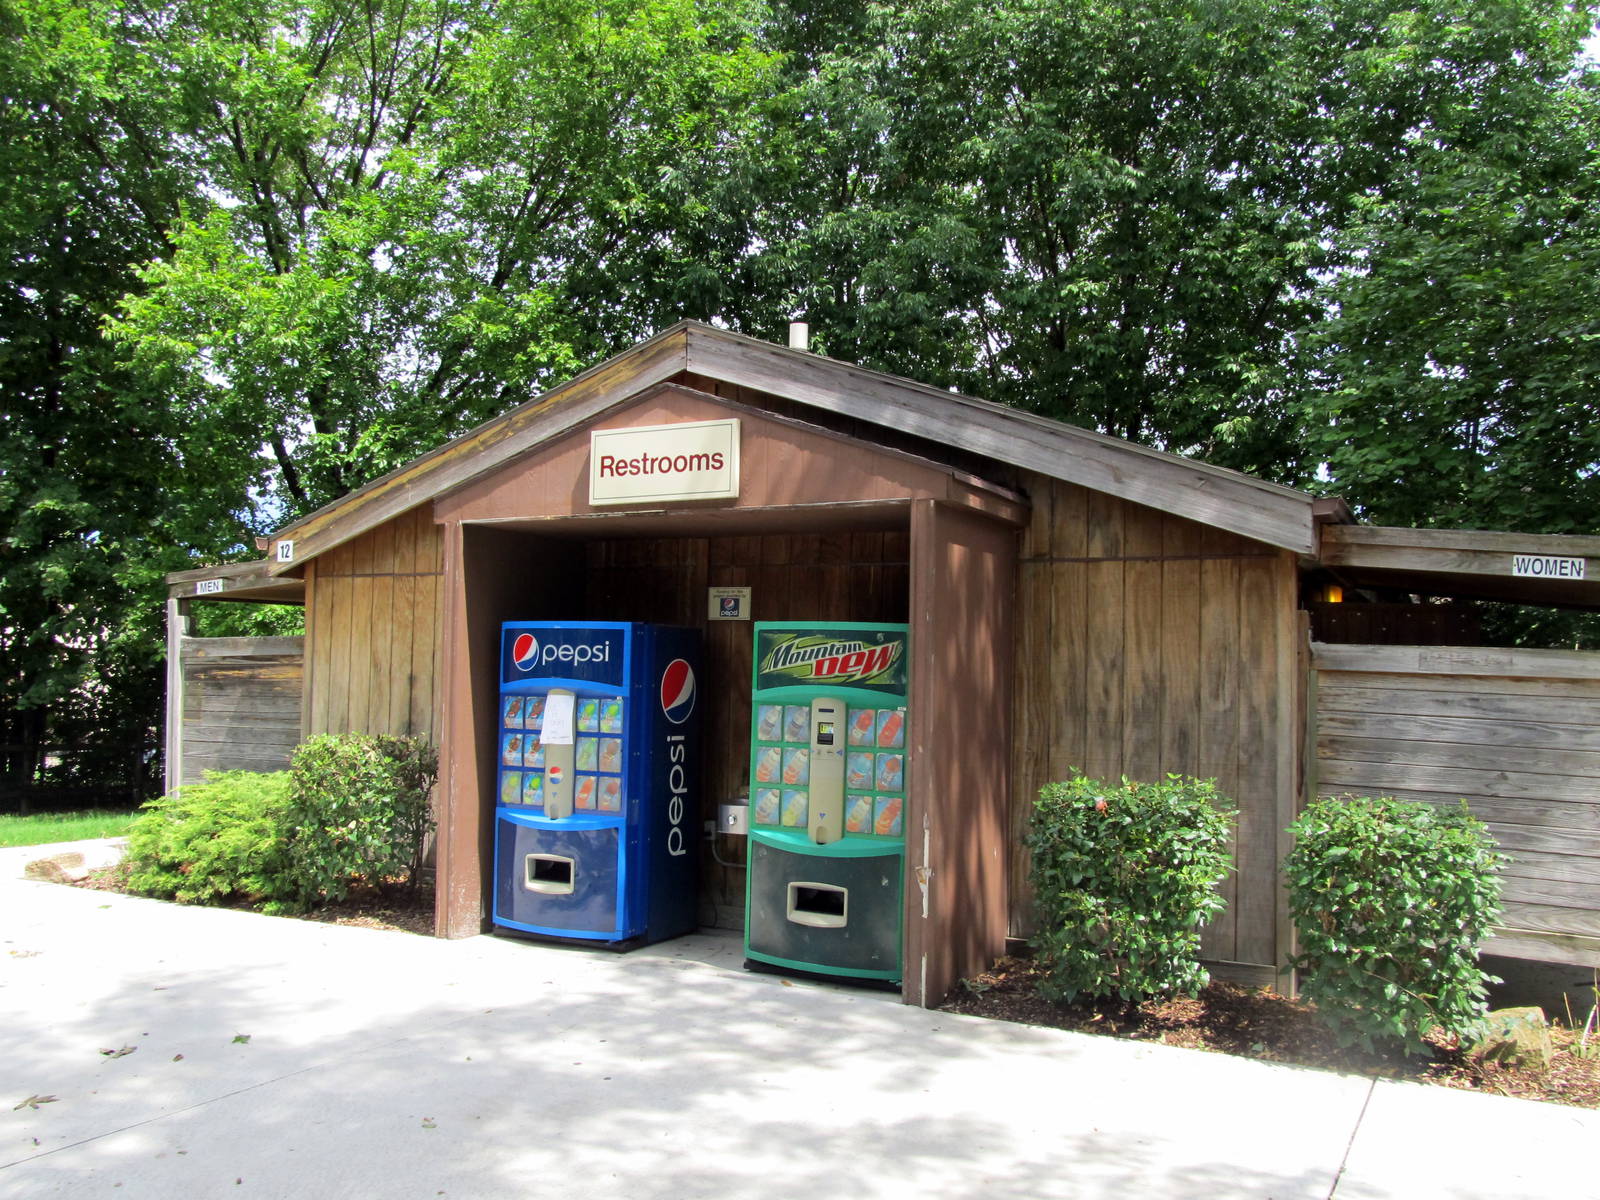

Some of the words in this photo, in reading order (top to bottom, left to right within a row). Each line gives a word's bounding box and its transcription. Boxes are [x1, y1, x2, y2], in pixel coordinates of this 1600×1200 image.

[600, 452, 724, 477] Restrooms
[280, 544, 291, 559] 12
[1516, 557, 1582, 577] WOMEN
[199, 580, 220, 593] MEN
[542, 640, 610, 666] pepsi
[769, 641, 863, 669] Mountain
[667, 735, 688, 857] pepsi
